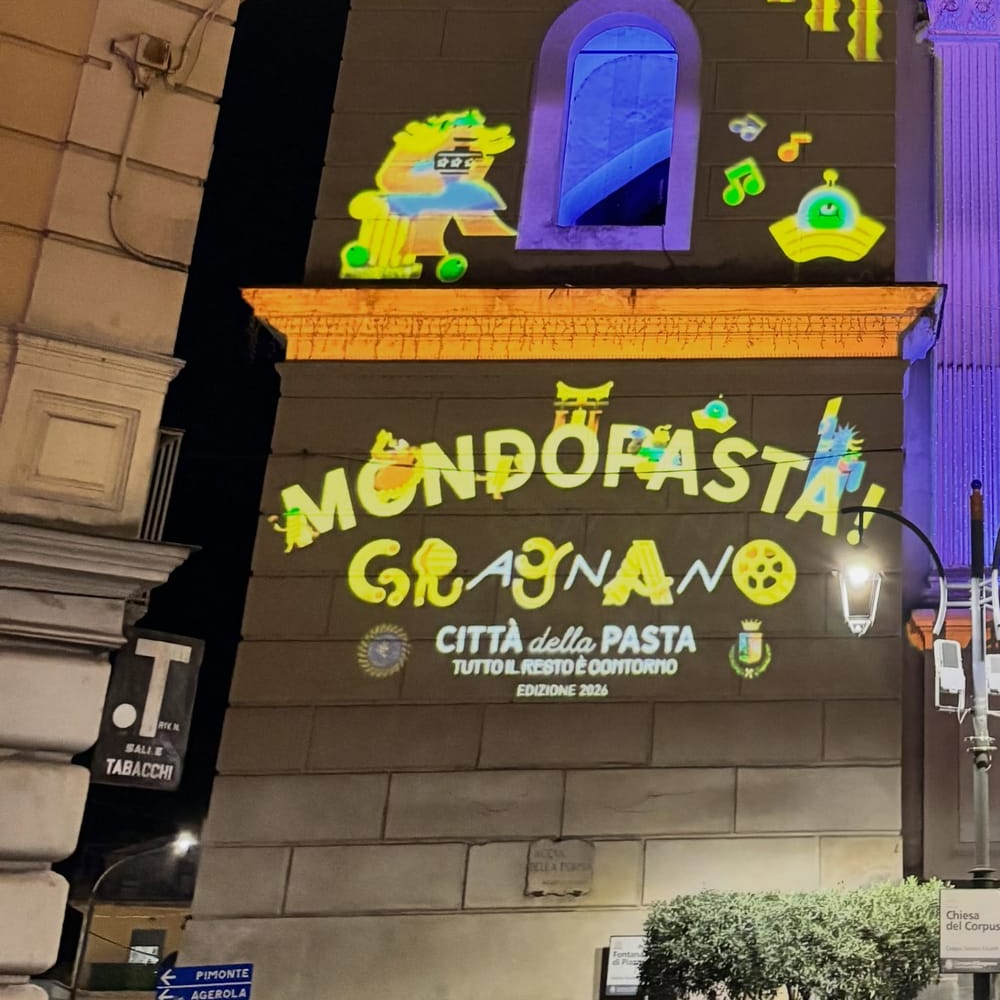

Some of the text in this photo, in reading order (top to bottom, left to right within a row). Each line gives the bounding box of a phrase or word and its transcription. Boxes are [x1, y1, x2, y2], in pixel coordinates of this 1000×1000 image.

[435, 617, 697, 655] CITTÀ della PASTA
[452, 658, 504, 675] TUTTO
[505, 658, 520, 675] IL
[520, 658, 574, 675] RESTO
[588, 658, 679, 675] CONTORNO
[134, 637, 193, 738] T
[516, 684, 609, 697] EDIZIONE 2026
[106, 758, 174, 780] TABACCHI
[946, 910, 980, 920] Chiesa
[946, 921, 962, 931] del
[964, 921, 1000, 933] Corpus
[195, 968, 250, 981] PIMONTE
[190, 988, 248, 1000] AGEROLA
